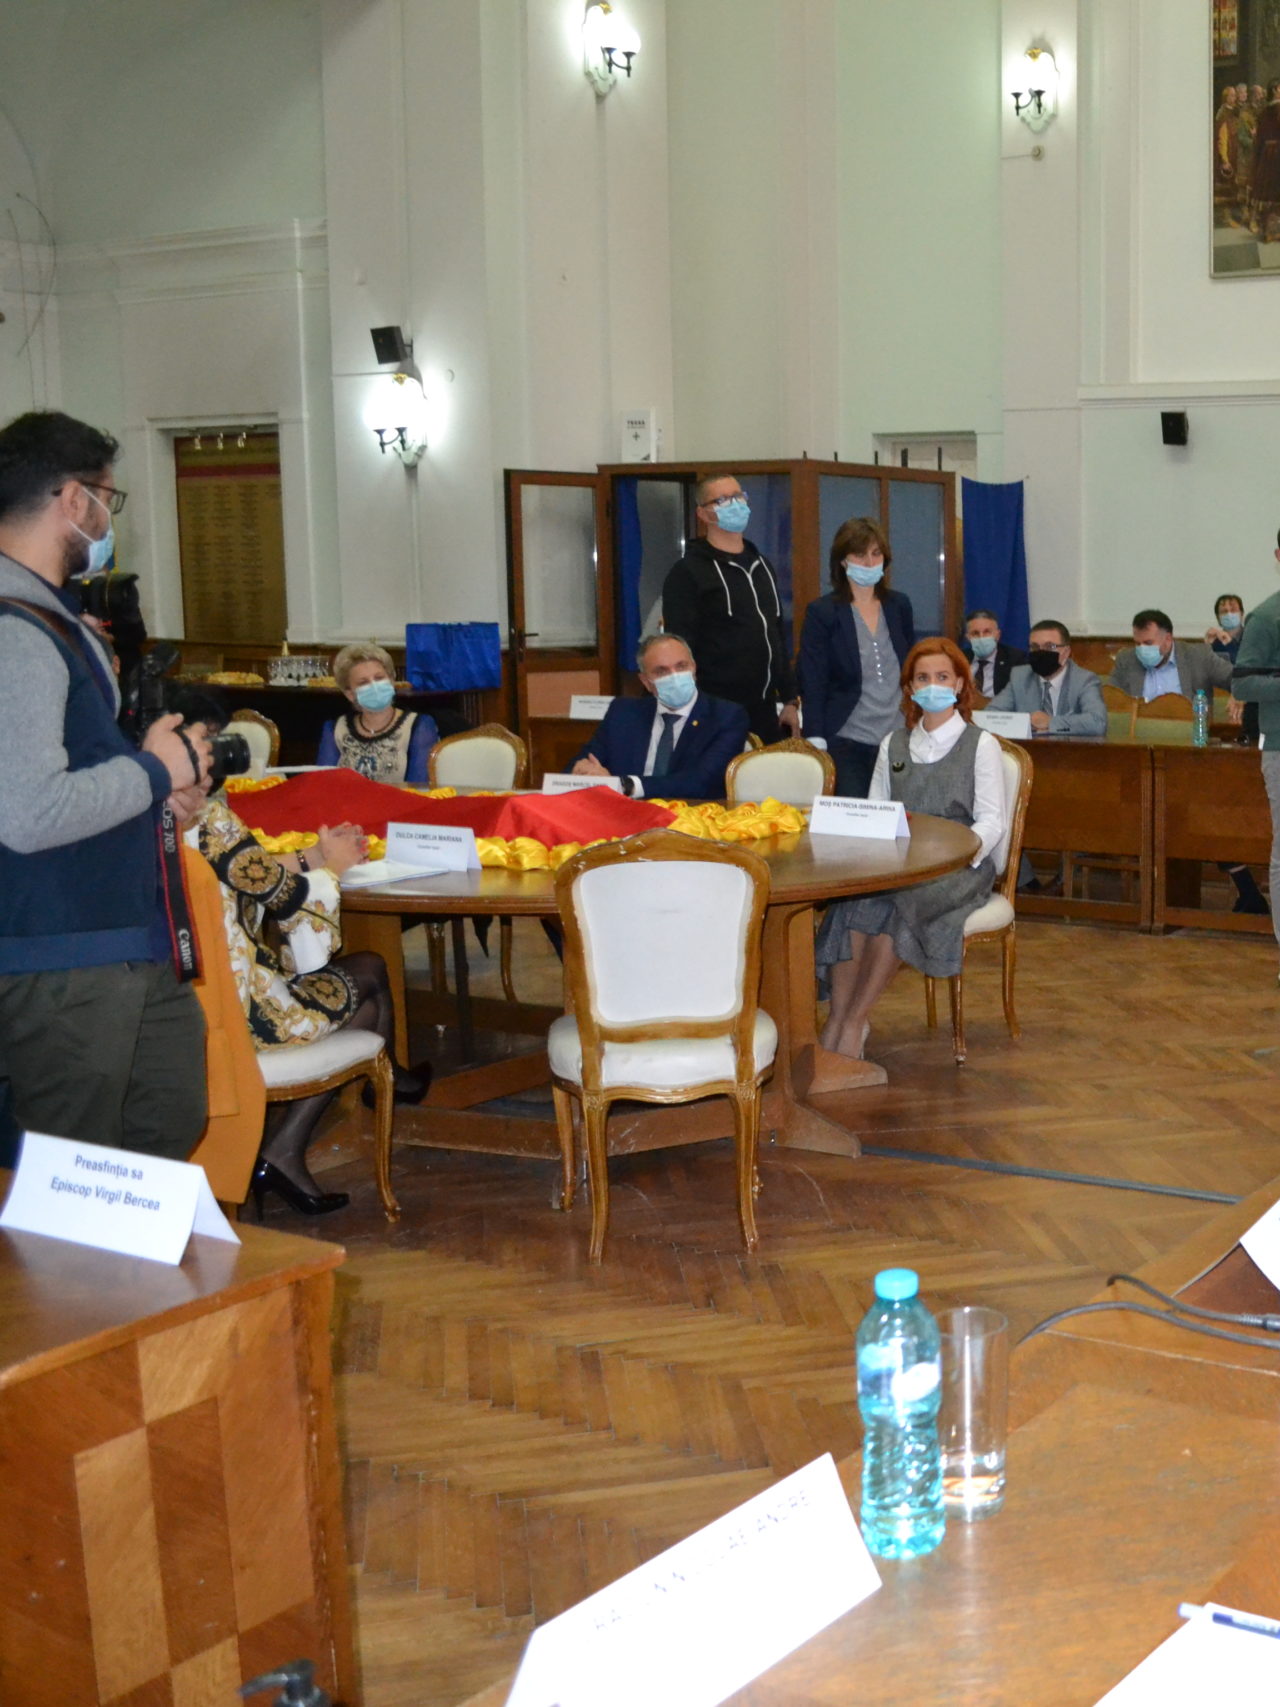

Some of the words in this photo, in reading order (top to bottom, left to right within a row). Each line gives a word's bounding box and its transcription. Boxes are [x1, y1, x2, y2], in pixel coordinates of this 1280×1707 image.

[162, 800, 174, 829] OS
[178, 928, 193, 970] Canon
[130, 1168, 144, 1181] sa
[50, 1176, 92, 1198] Episcop
[95, 1184, 122, 1205] Virgil
[123, 1191, 161, 1211] Bercea
